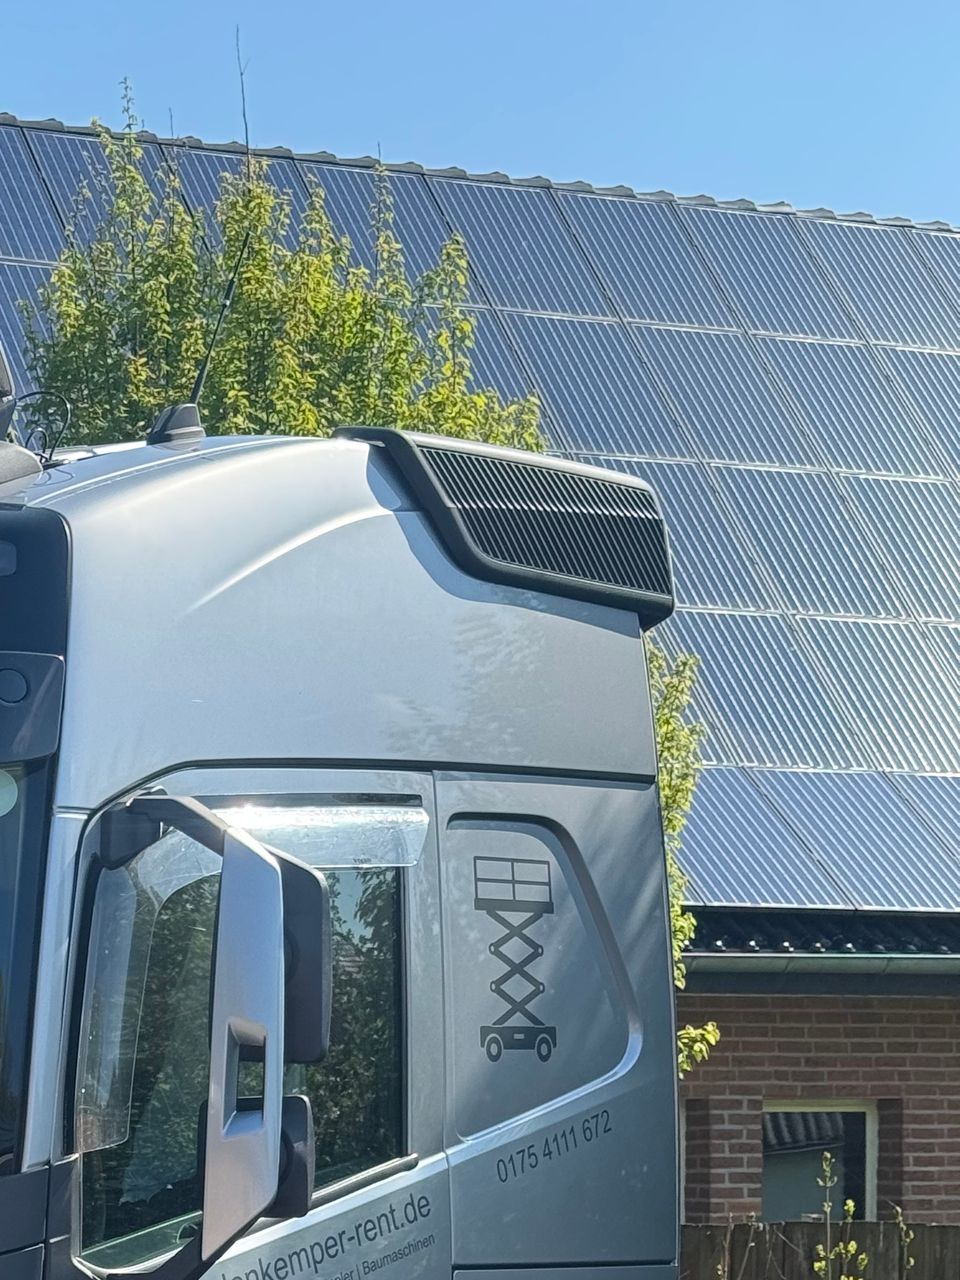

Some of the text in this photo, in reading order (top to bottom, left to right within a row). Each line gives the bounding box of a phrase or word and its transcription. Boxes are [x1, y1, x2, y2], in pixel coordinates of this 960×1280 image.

[496, 1110, 613, 1183] 0175 4111 672
[361, 1232, 436, 1276] Baumaschinen
